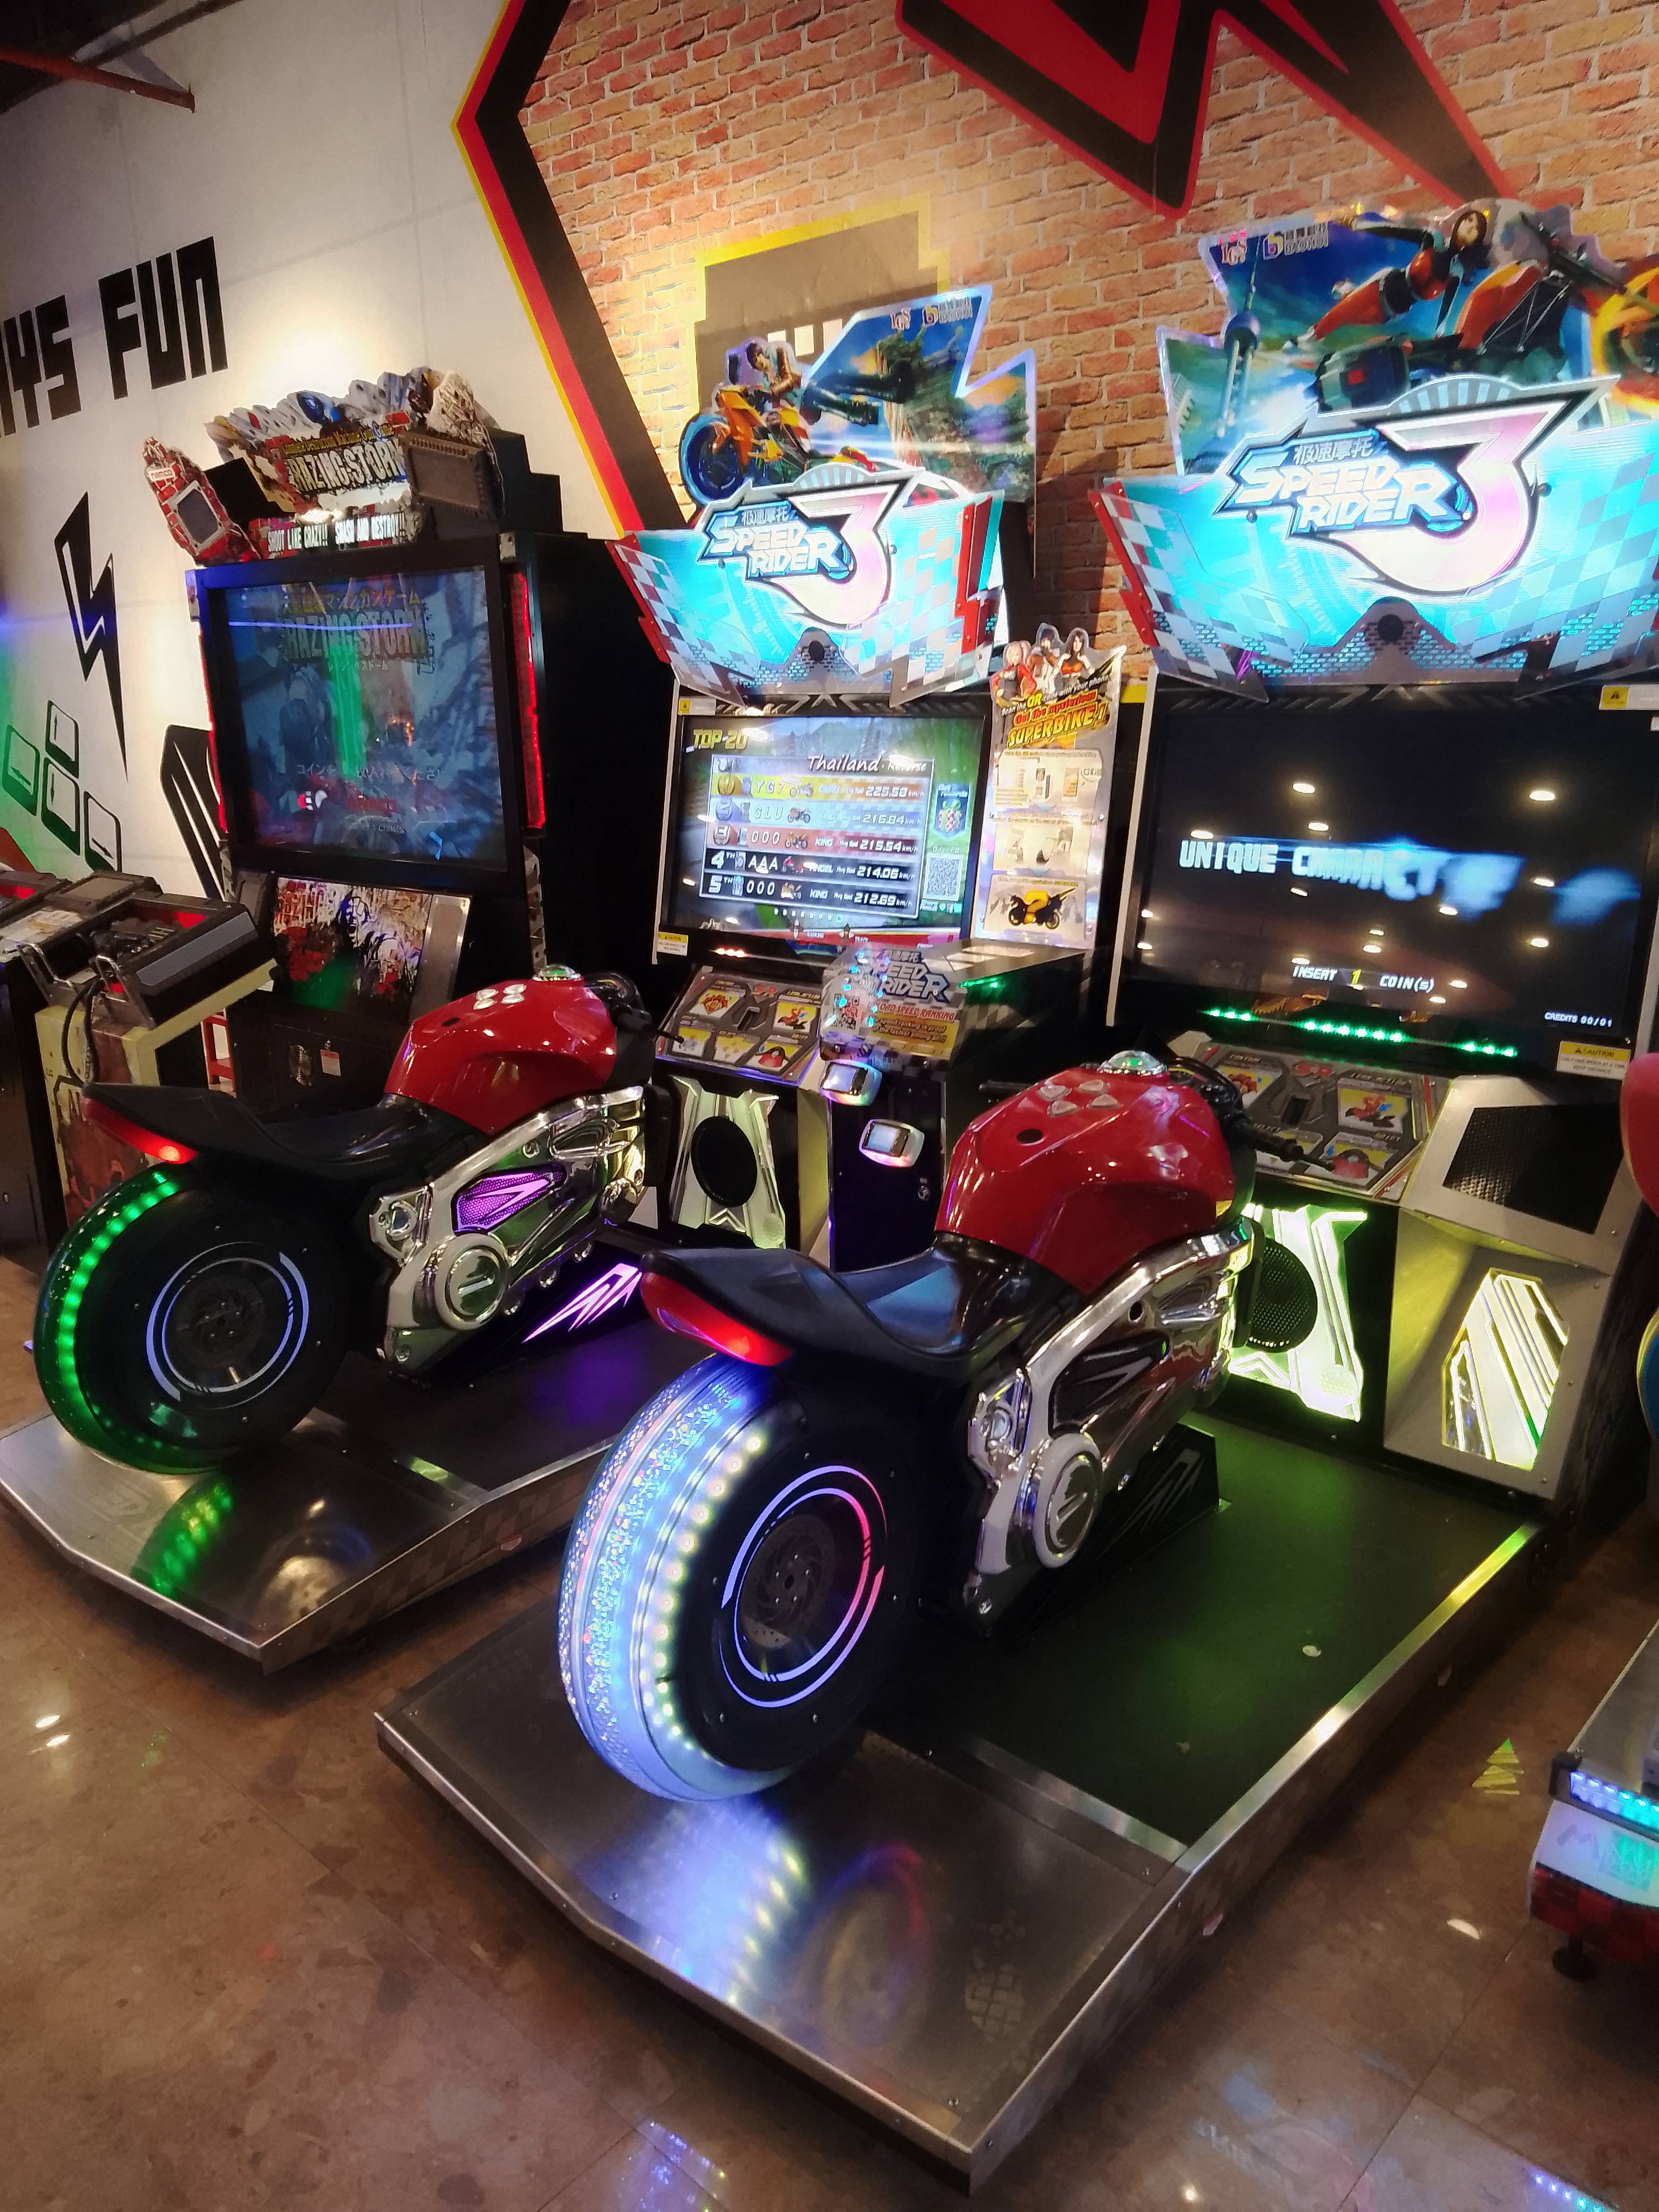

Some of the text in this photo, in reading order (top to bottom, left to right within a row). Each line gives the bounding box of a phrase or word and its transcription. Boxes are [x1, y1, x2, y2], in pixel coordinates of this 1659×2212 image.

[98, 236, 228, 400] FUN
[151, 470, 173, 478] namco
[1234, 451, 1401, 504] SPEED
[1297, 467, 1452, 531] RIDER
[1328, 398, 1570, 593] 3
[287, 527, 302, 550] LIKE
[357, 516, 369, 542] AND
[709, 514, 808, 554] SPEED
[748, 532, 840, 574] RIDER
[769, 483, 900, 626] 3
[1074, 682, 1088, 693] your
[807, 754, 882, 772] Thailand
[815, 837, 833, 847] KING
[860, 839, 902, 852] 215.54
[1179, 840, 1278, 875] UNIQUE
[748, 855, 778, 870] AAA
[857, 865, 899, 879] 214.06
[809, 889, 829, 899] KING
[854, 892, 897, 906] 212.69
[879, 974, 950, 1002] RIDER
[1293, 966, 1339, 981] INSERT
[1351, 969, 1362, 985] 1
[898, 1003, 920, 1017] SPEED
[920, 1009, 956, 1021] RANKING
[1544, 1011, 1612, 1027] CREDITS 00/01
